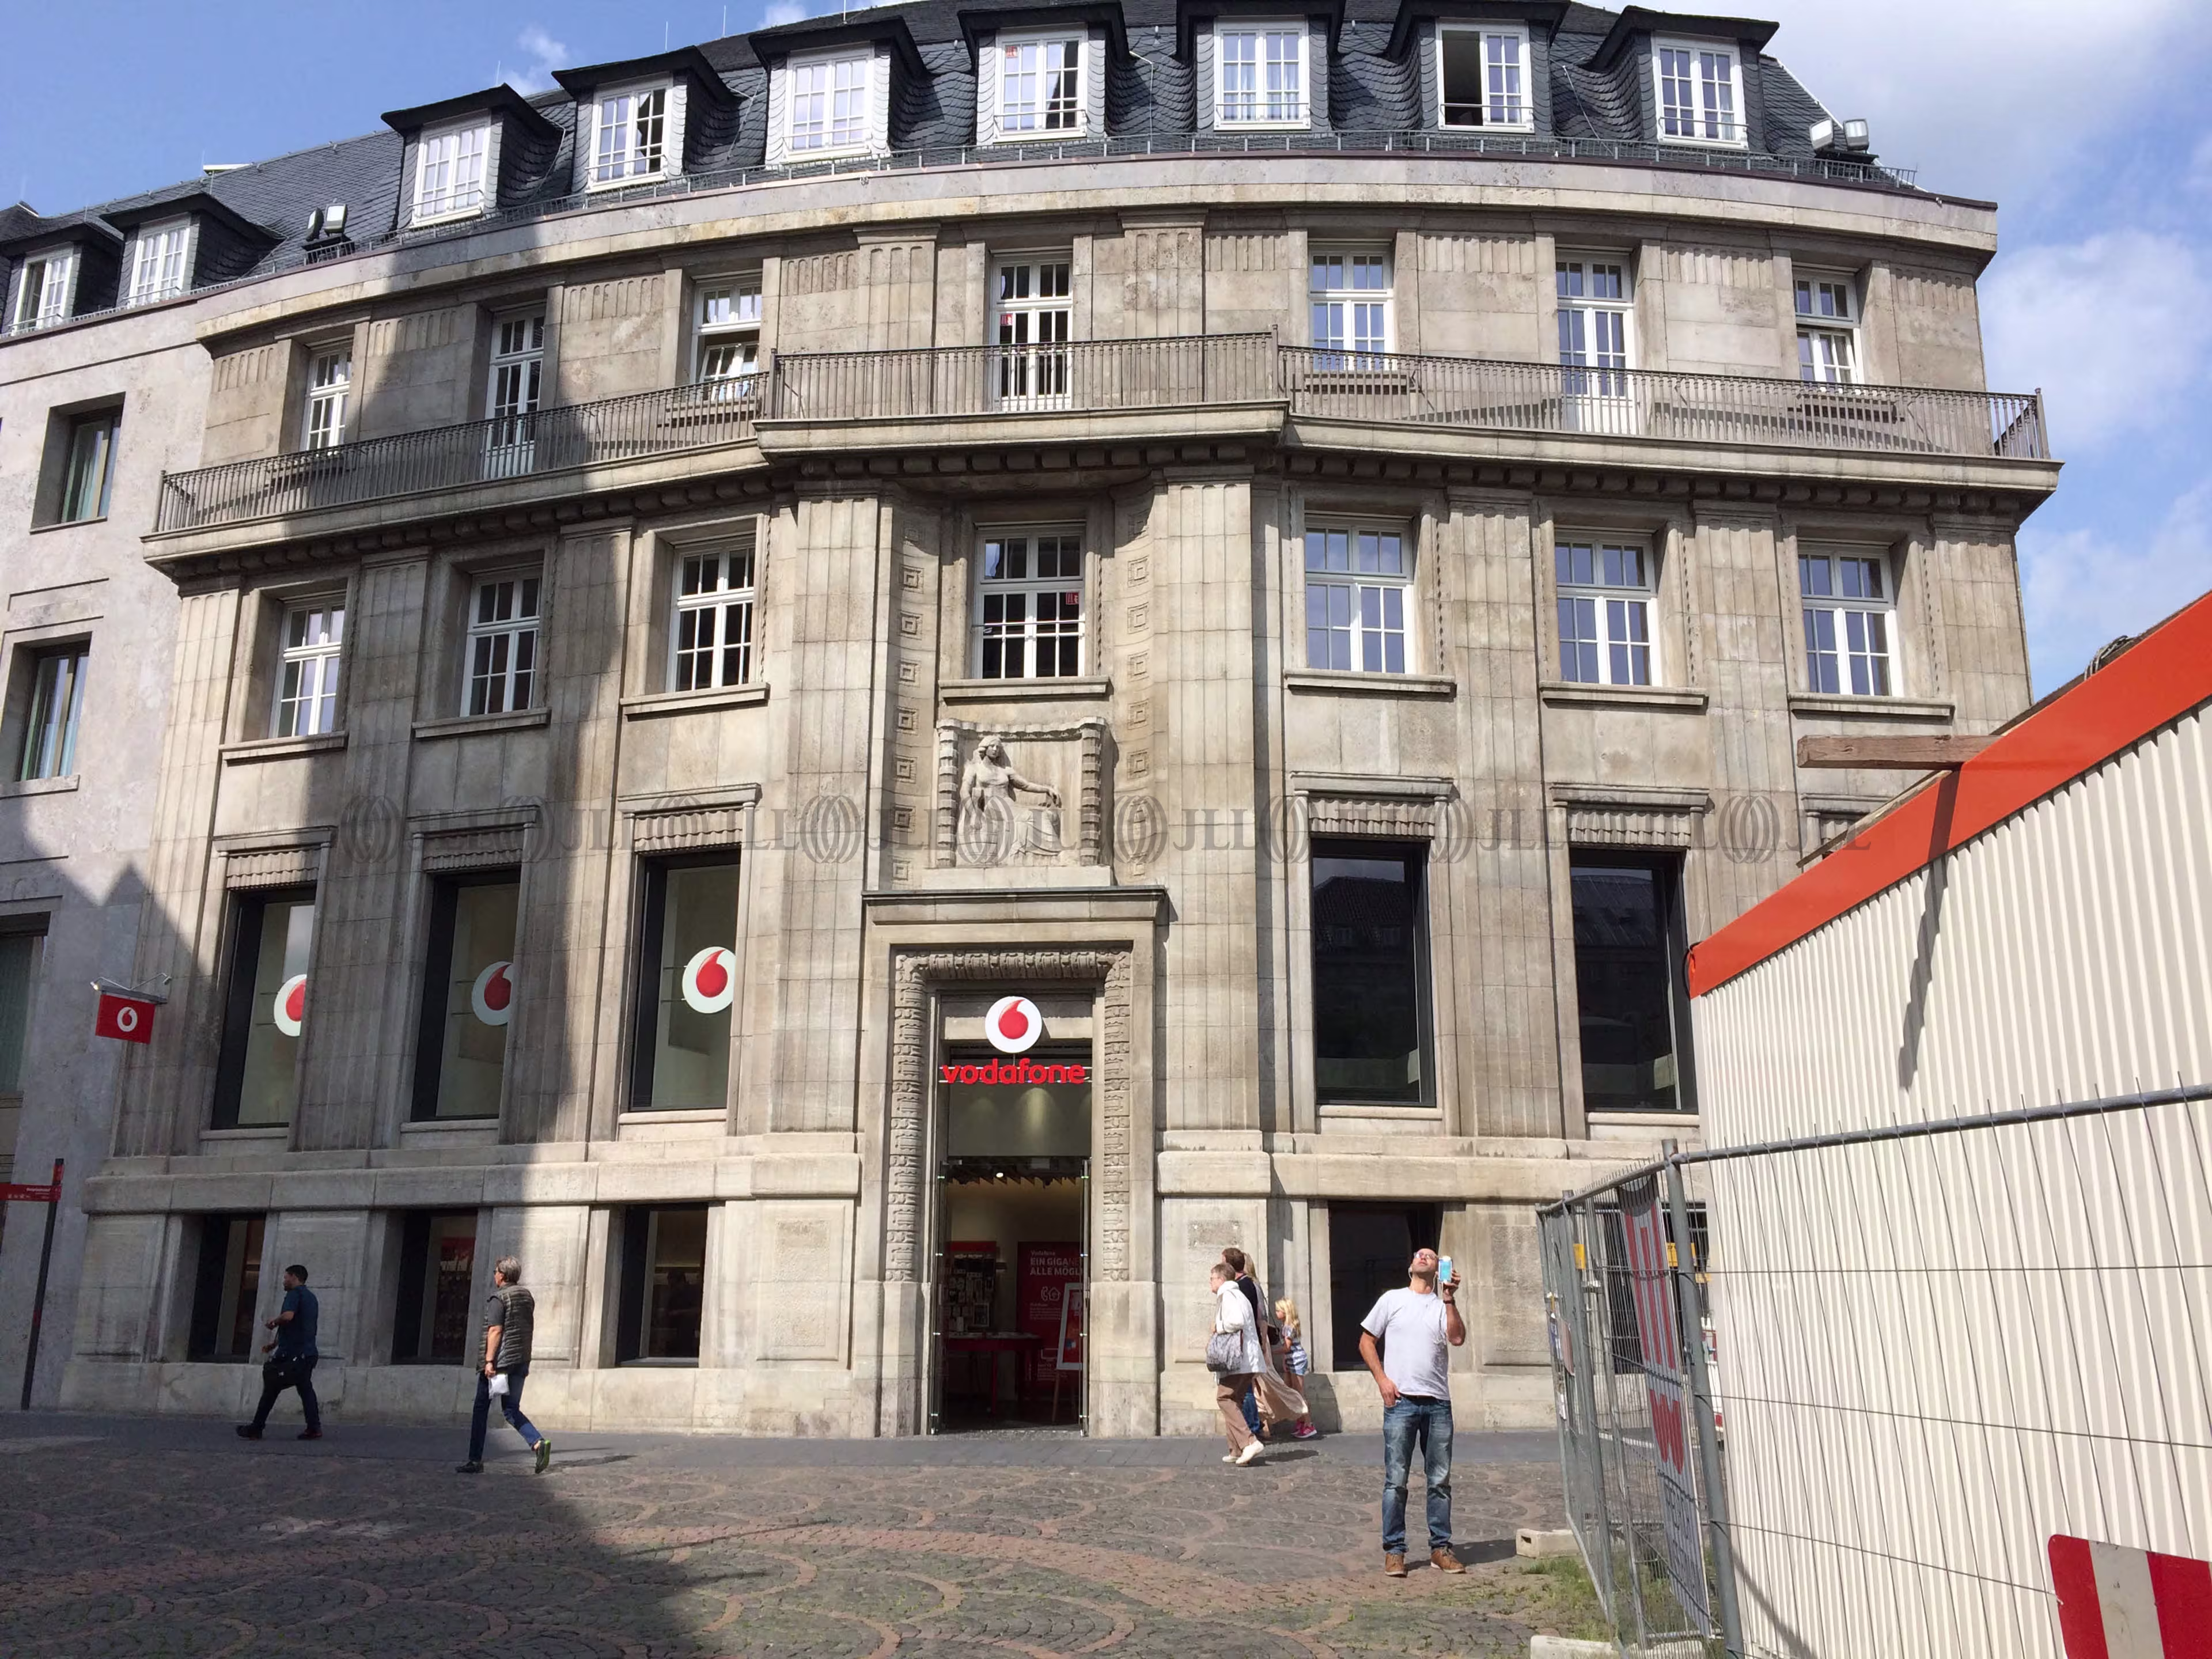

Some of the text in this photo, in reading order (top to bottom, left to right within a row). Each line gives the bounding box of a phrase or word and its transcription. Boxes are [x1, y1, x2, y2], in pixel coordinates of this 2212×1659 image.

[942, 1058, 1085, 1085] vodafone
[1030, 1257, 1046, 1266] EIN
[1030, 1267, 1053, 1275] ALLE
